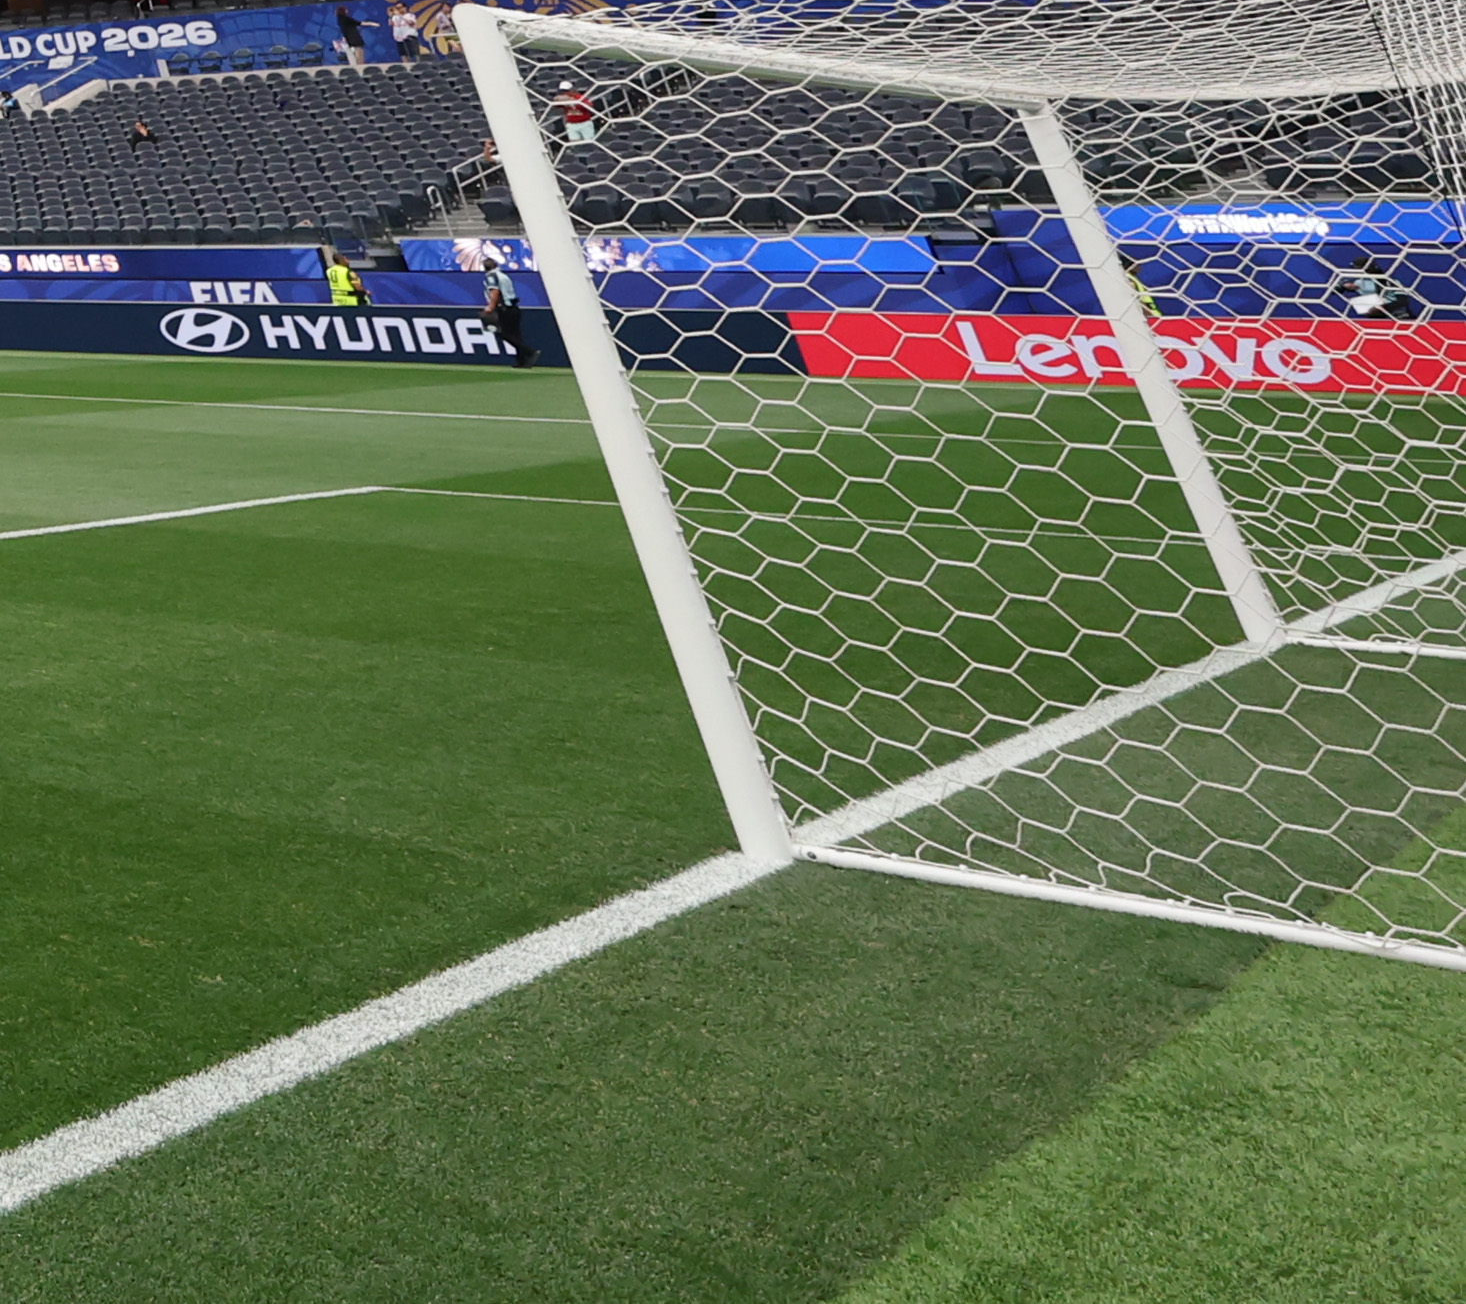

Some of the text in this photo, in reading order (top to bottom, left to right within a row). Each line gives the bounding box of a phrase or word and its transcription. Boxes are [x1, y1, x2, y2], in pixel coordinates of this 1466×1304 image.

[35, 30, 97, 57] CUP
[100, 21, 217, 52] 2026
[16, 253, 120, 273] ANGELES
[259, 315, 517, 355] HYUNDA
